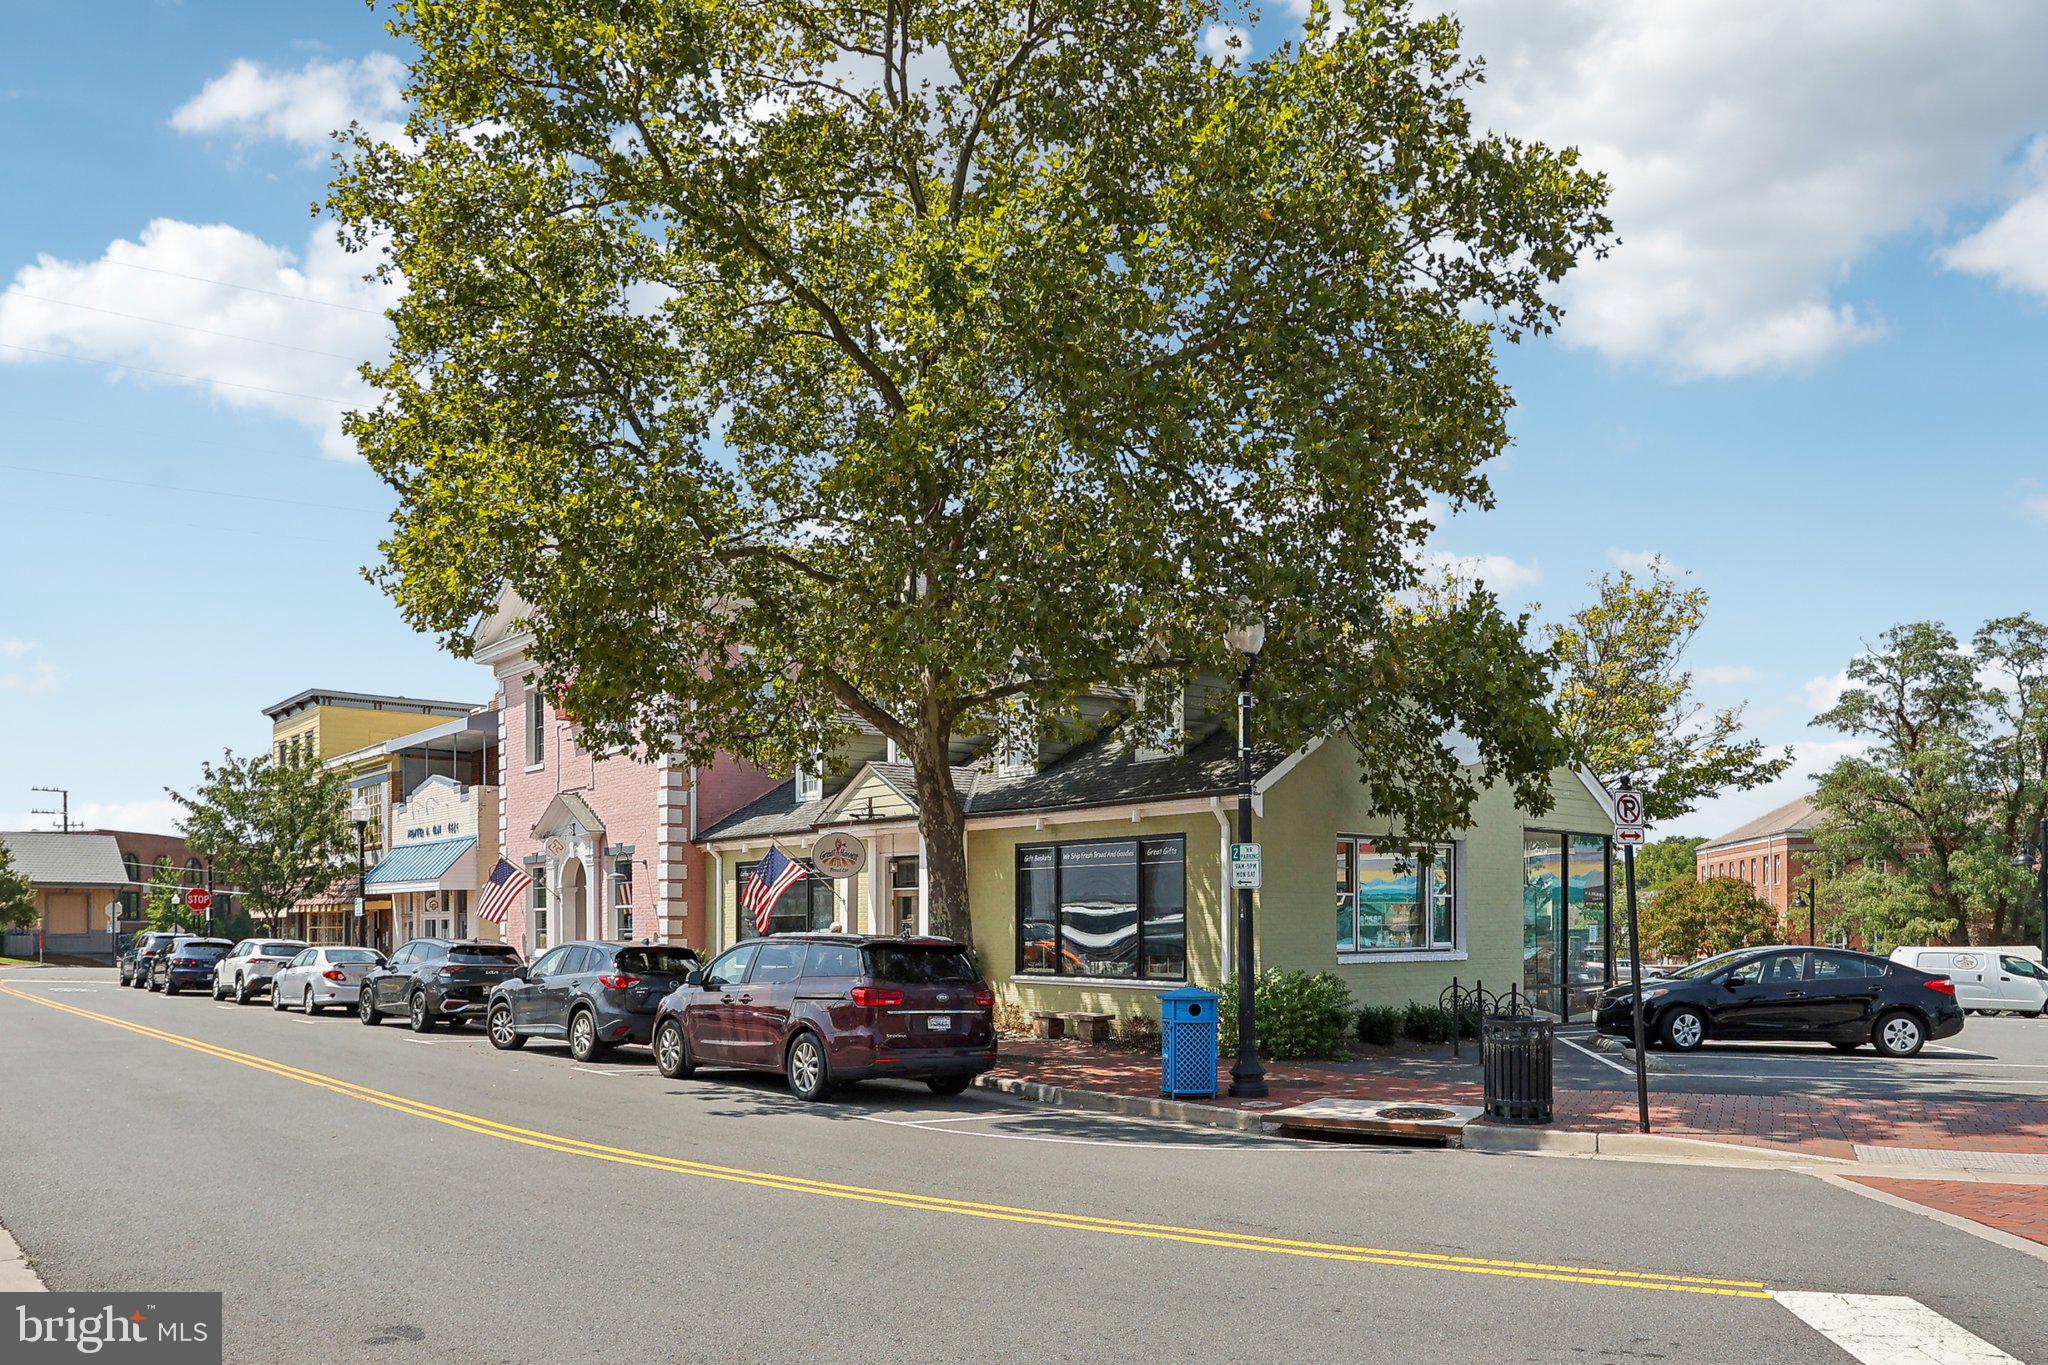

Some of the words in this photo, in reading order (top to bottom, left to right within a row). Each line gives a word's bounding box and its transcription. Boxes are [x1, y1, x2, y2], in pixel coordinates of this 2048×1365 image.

[1070, 852, 1081, 860] Ship
[1081, 851, 1093, 860] Fresh
[1147, 847, 1162, 856] Great
[1163, 847, 1178, 855] Gifts
[1233, 847, 1239, 859] 2
[1024, 854, 1034, 862] Gift
[1034, 854, 1052, 862] Baskets
[187, 895, 209, 904] STOP
